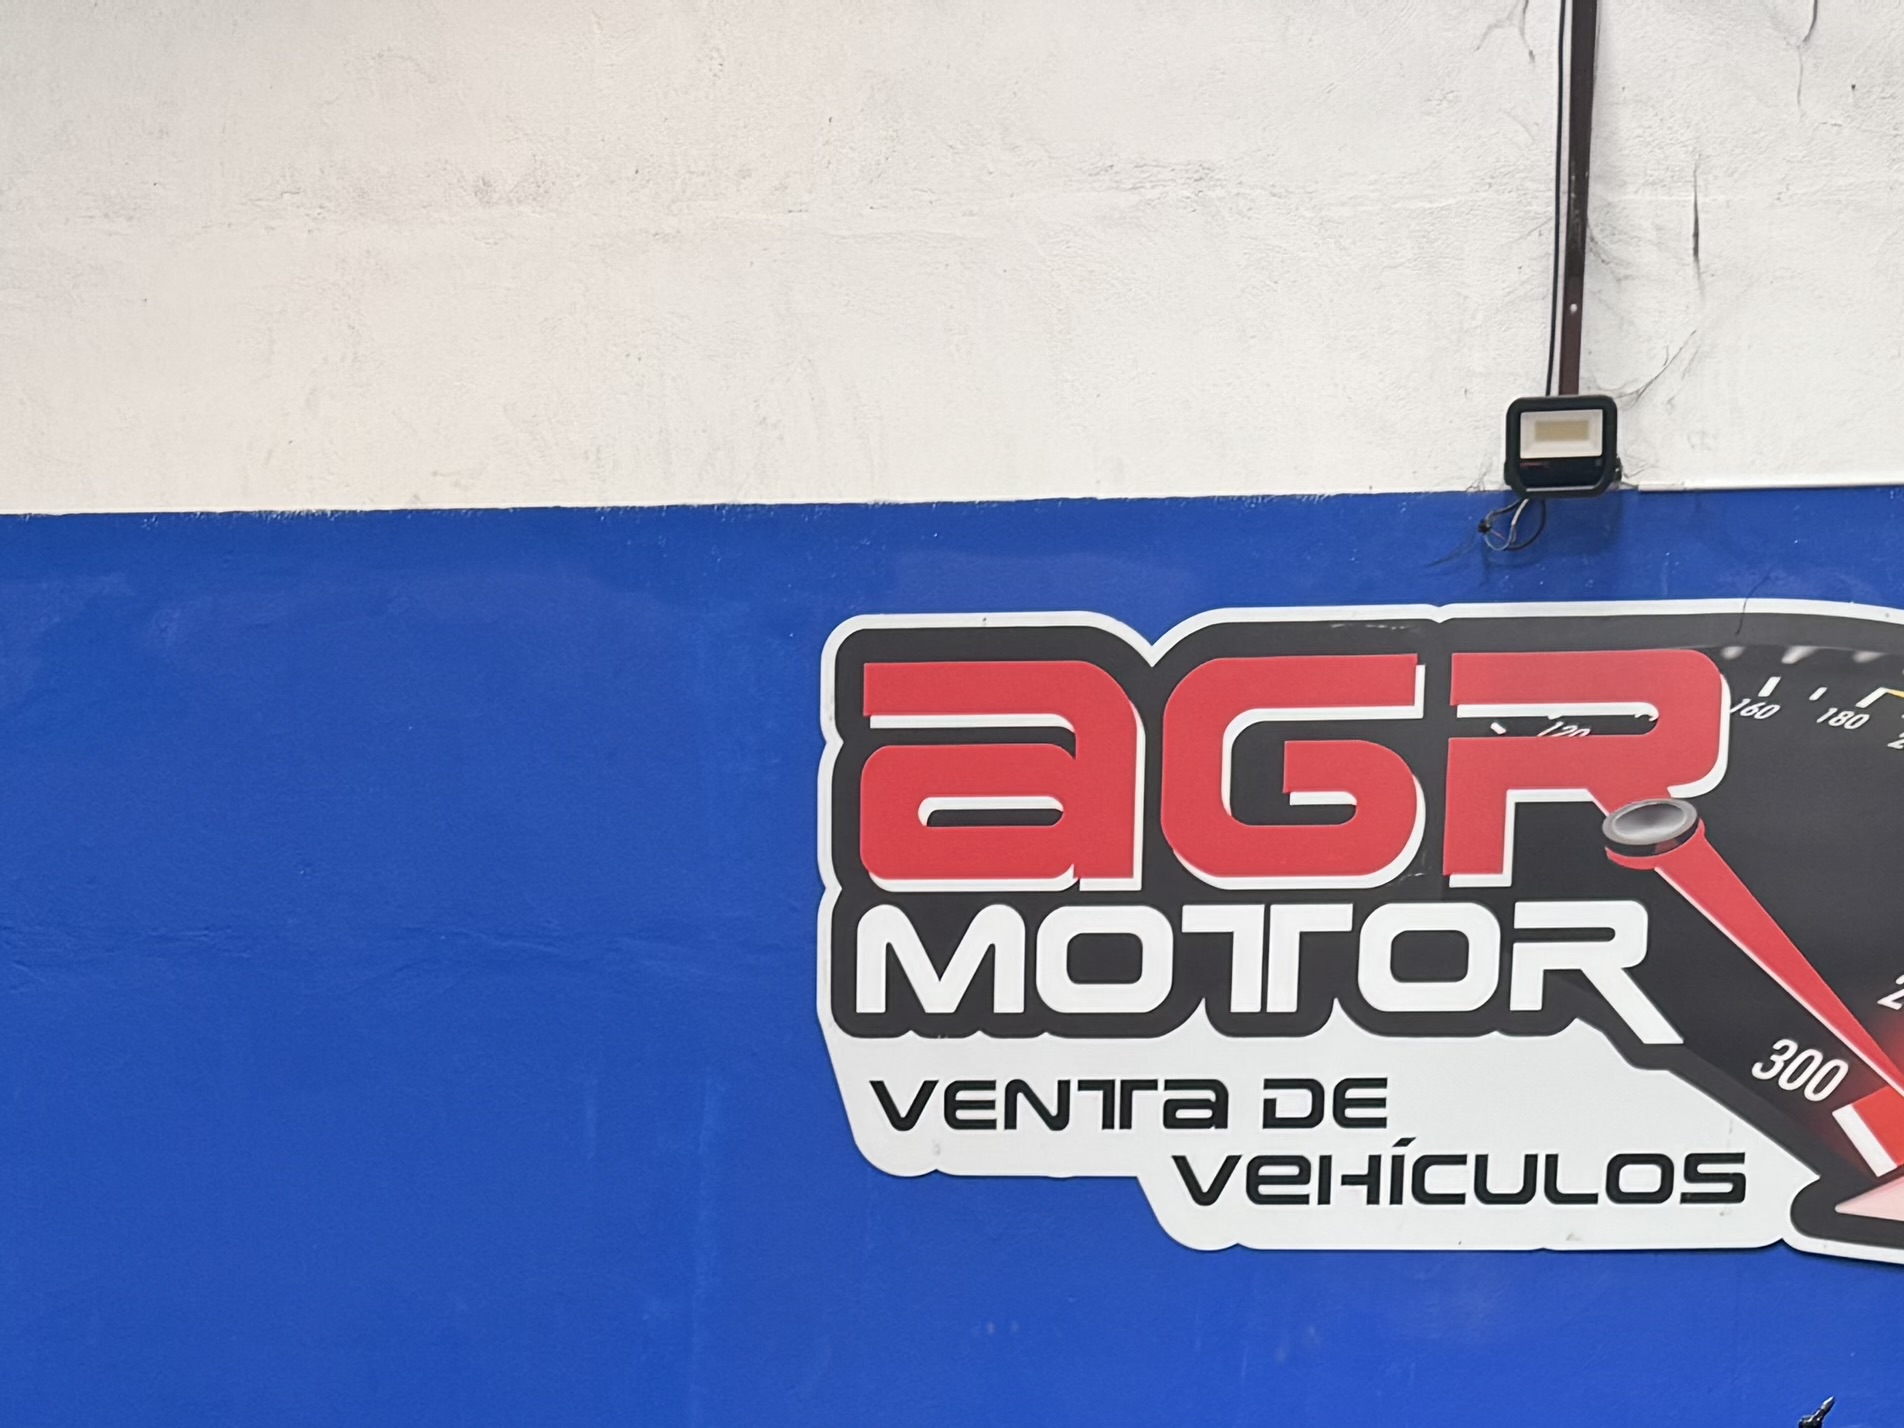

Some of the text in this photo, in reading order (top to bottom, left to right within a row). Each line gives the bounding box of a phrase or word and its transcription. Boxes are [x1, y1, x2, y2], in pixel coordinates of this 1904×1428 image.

[1730, 697, 1781, 720] 160
[1815, 706, 1870, 730] 180
[856, 901, 1685, 1044] MOTOR
[1750, 1038, 1849, 1102] 300
[1262, 1076, 1388, 1130] DE
